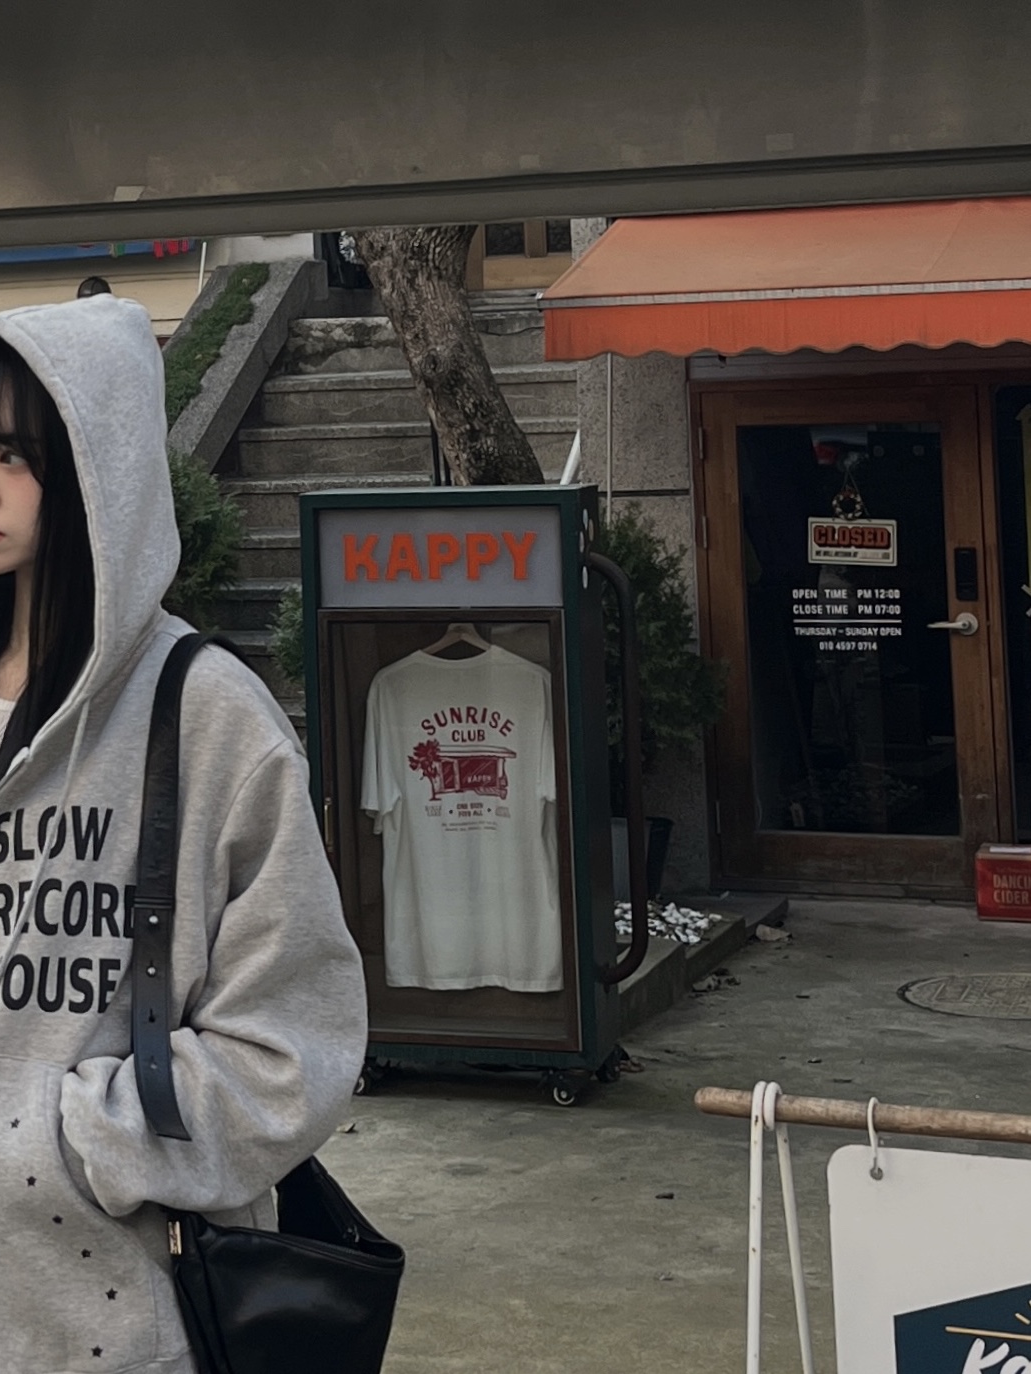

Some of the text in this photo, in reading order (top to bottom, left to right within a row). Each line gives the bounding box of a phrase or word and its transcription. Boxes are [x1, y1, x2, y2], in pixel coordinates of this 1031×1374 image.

[814, 525, 891, 549] CLOSED
[343, 532, 537, 582] KAPPY
[792, 589, 901, 599] OPEN TIME PM 12:00
[793, 604, 901, 615] CLOSE TIME PM 07:00
[794, 627, 836, 636] THURSDAY
[845, 627, 878, 637] SUNDAY
[879, 627, 902, 637] OPEN
[819, 641, 834, 651] 010
[421, 706, 515, 737] SUNRISE
[452, 730, 485, 742] CLUB
[993, 889, 1029, 904] CIDER
